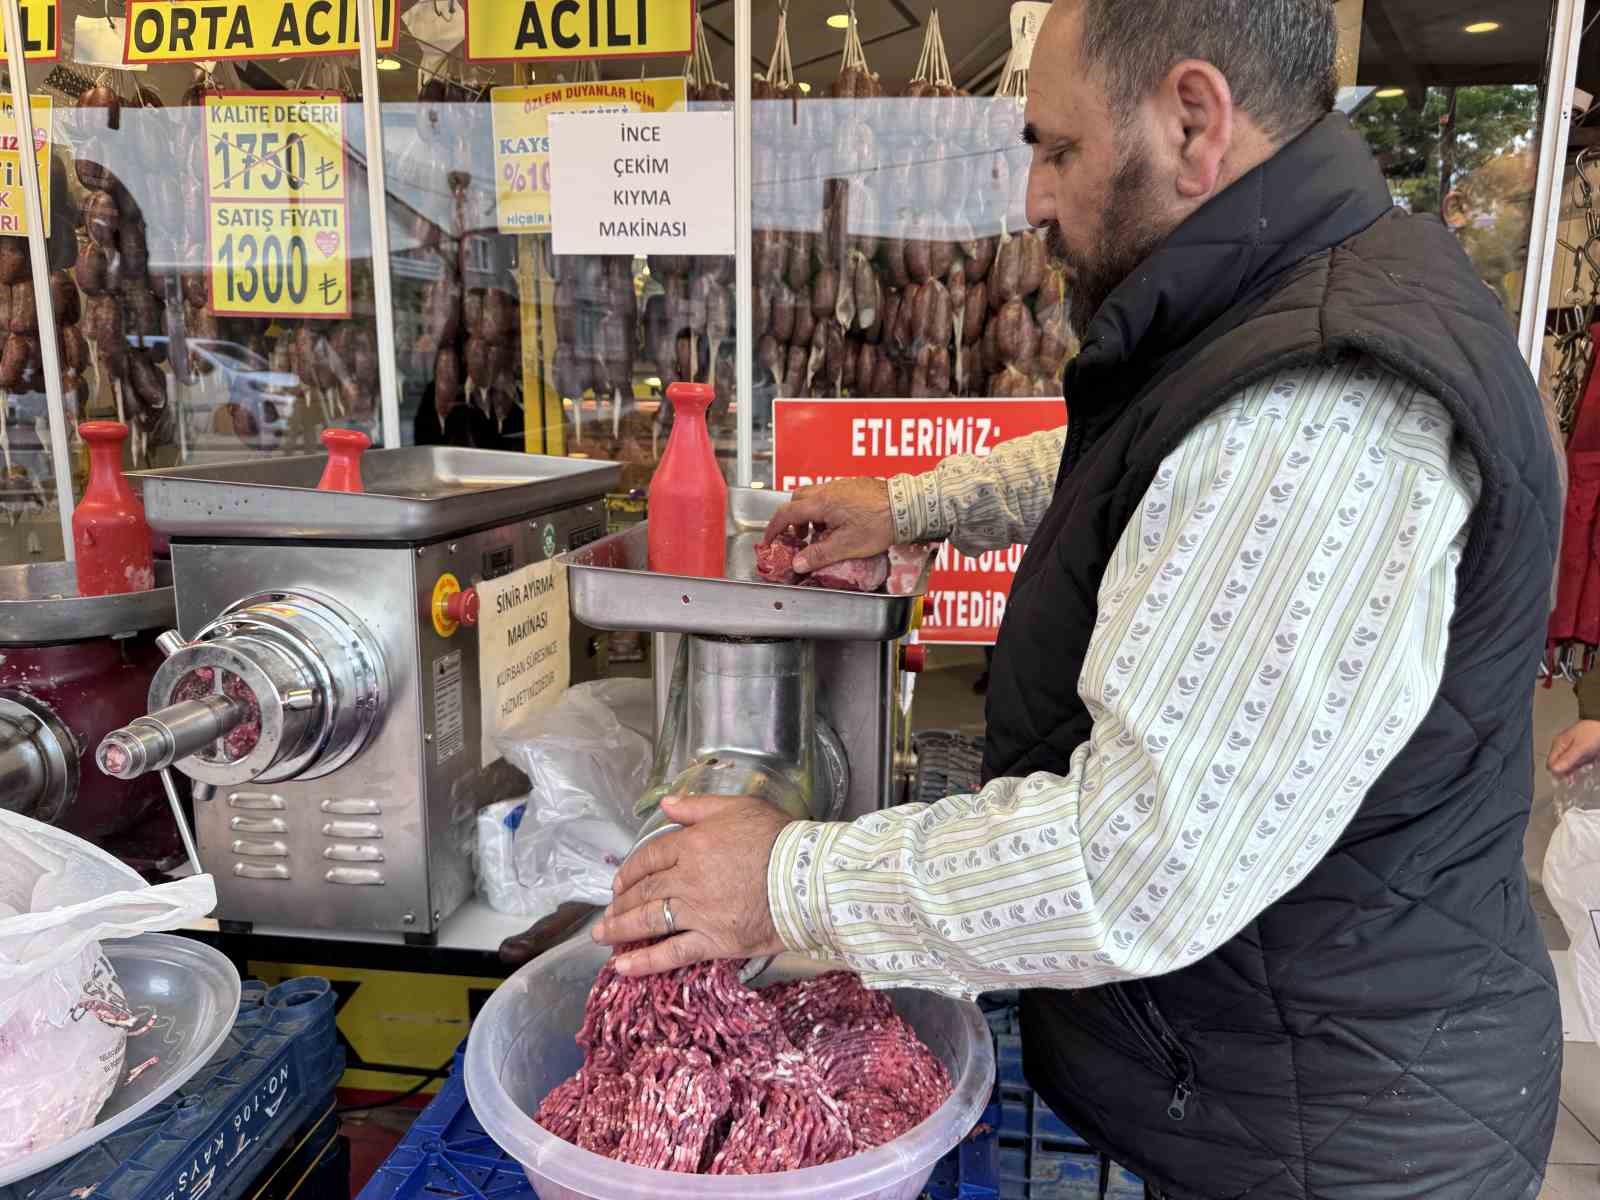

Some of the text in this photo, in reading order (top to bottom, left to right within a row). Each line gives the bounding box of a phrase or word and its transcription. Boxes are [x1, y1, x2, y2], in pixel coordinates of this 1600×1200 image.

[134, 5, 254, 53] ORTA
[515, 0, 647, 50] ACILI
[523, 88, 562, 114] ÖZLEM
[566, 84, 627, 99] DUYANLAR
[621, 123, 661, 142] İNCE
[499, 137, 550, 154] KAYS
[214, 131, 306, 191] 1750
[613, 154, 669, 178] ÇEKİM
[613, 190, 672, 206] KIYMA
[217, 208, 274, 232] SATIŞ
[599, 216, 687, 237] MAKİNASI
[218, 233, 308, 304] 1300
